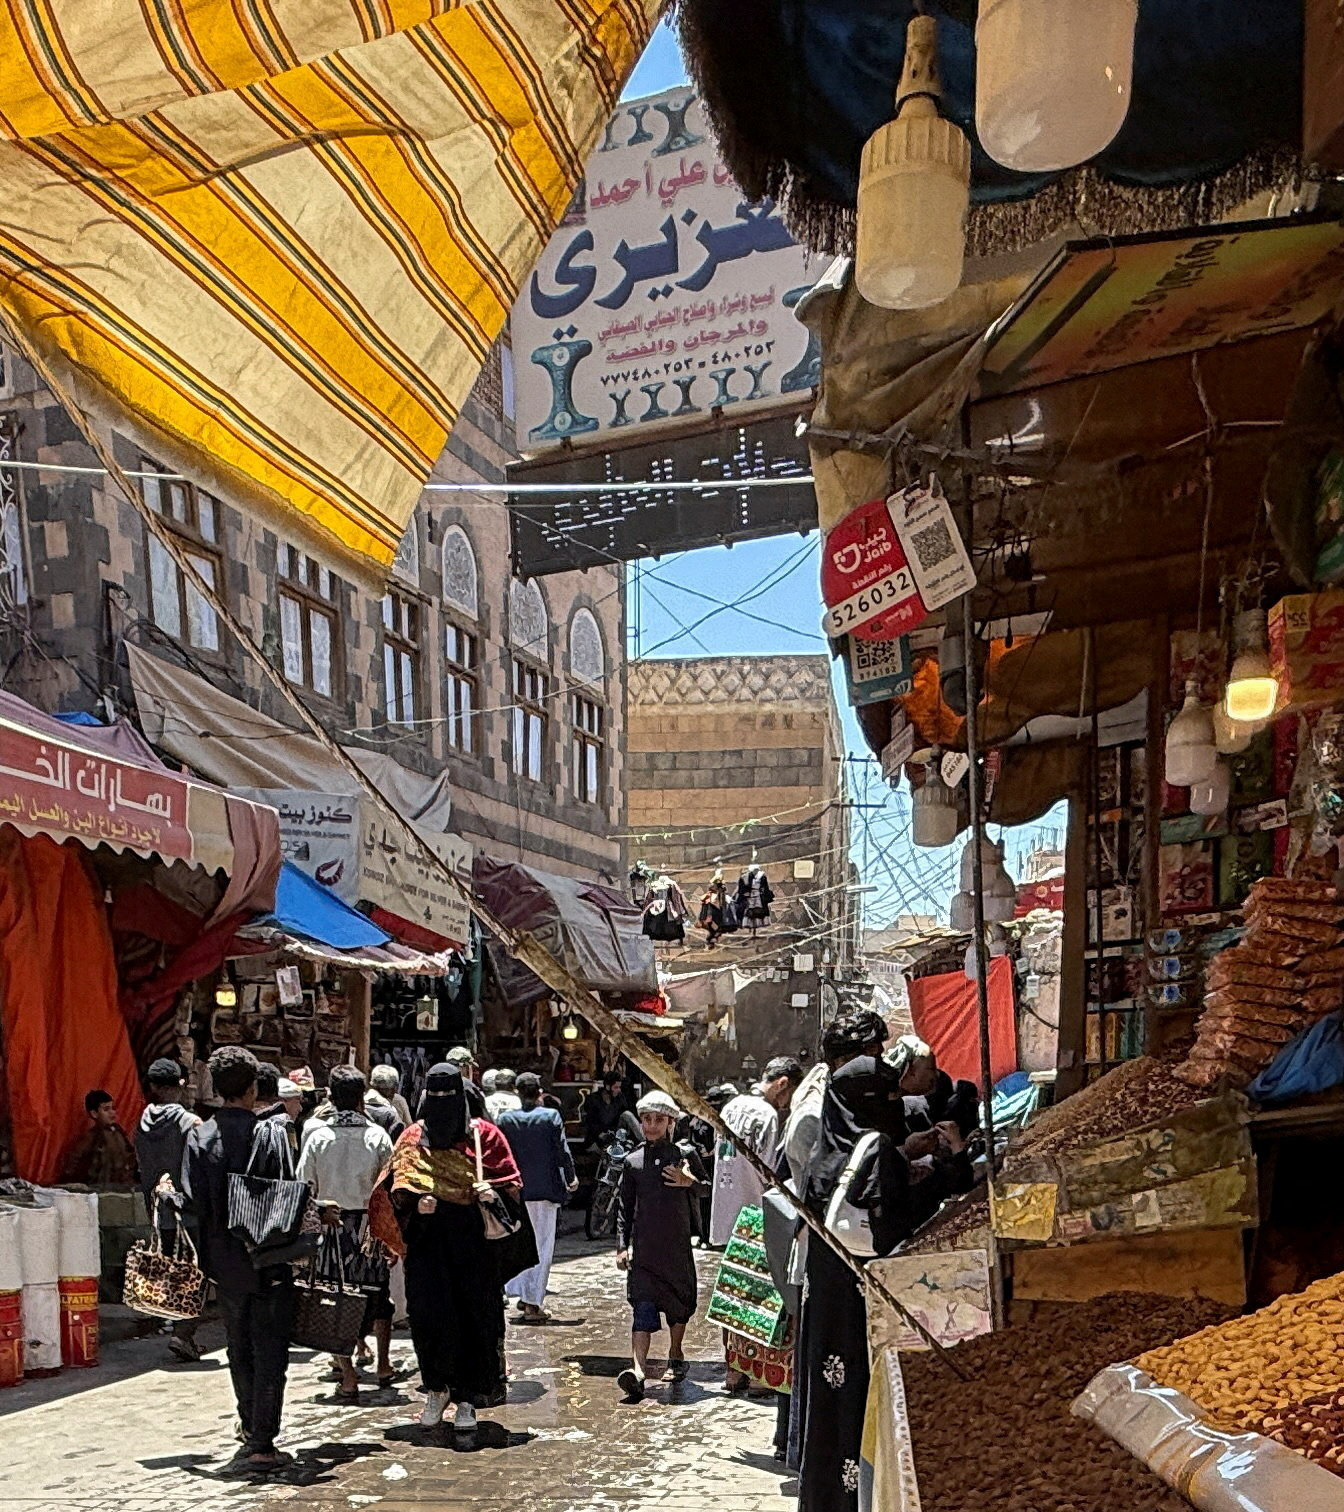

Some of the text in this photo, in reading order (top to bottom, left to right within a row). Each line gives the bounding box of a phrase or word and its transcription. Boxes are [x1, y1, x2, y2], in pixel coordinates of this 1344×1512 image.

[590, 160, 652, 210] أحمد
[658, 157, 707, 209] علي
[831, 571, 911, 628] 526032
[28, 797, 70, 829] والعسل
[76, 758, 172, 828] بهارات
[279, 803, 354, 826] كنوز بيت
